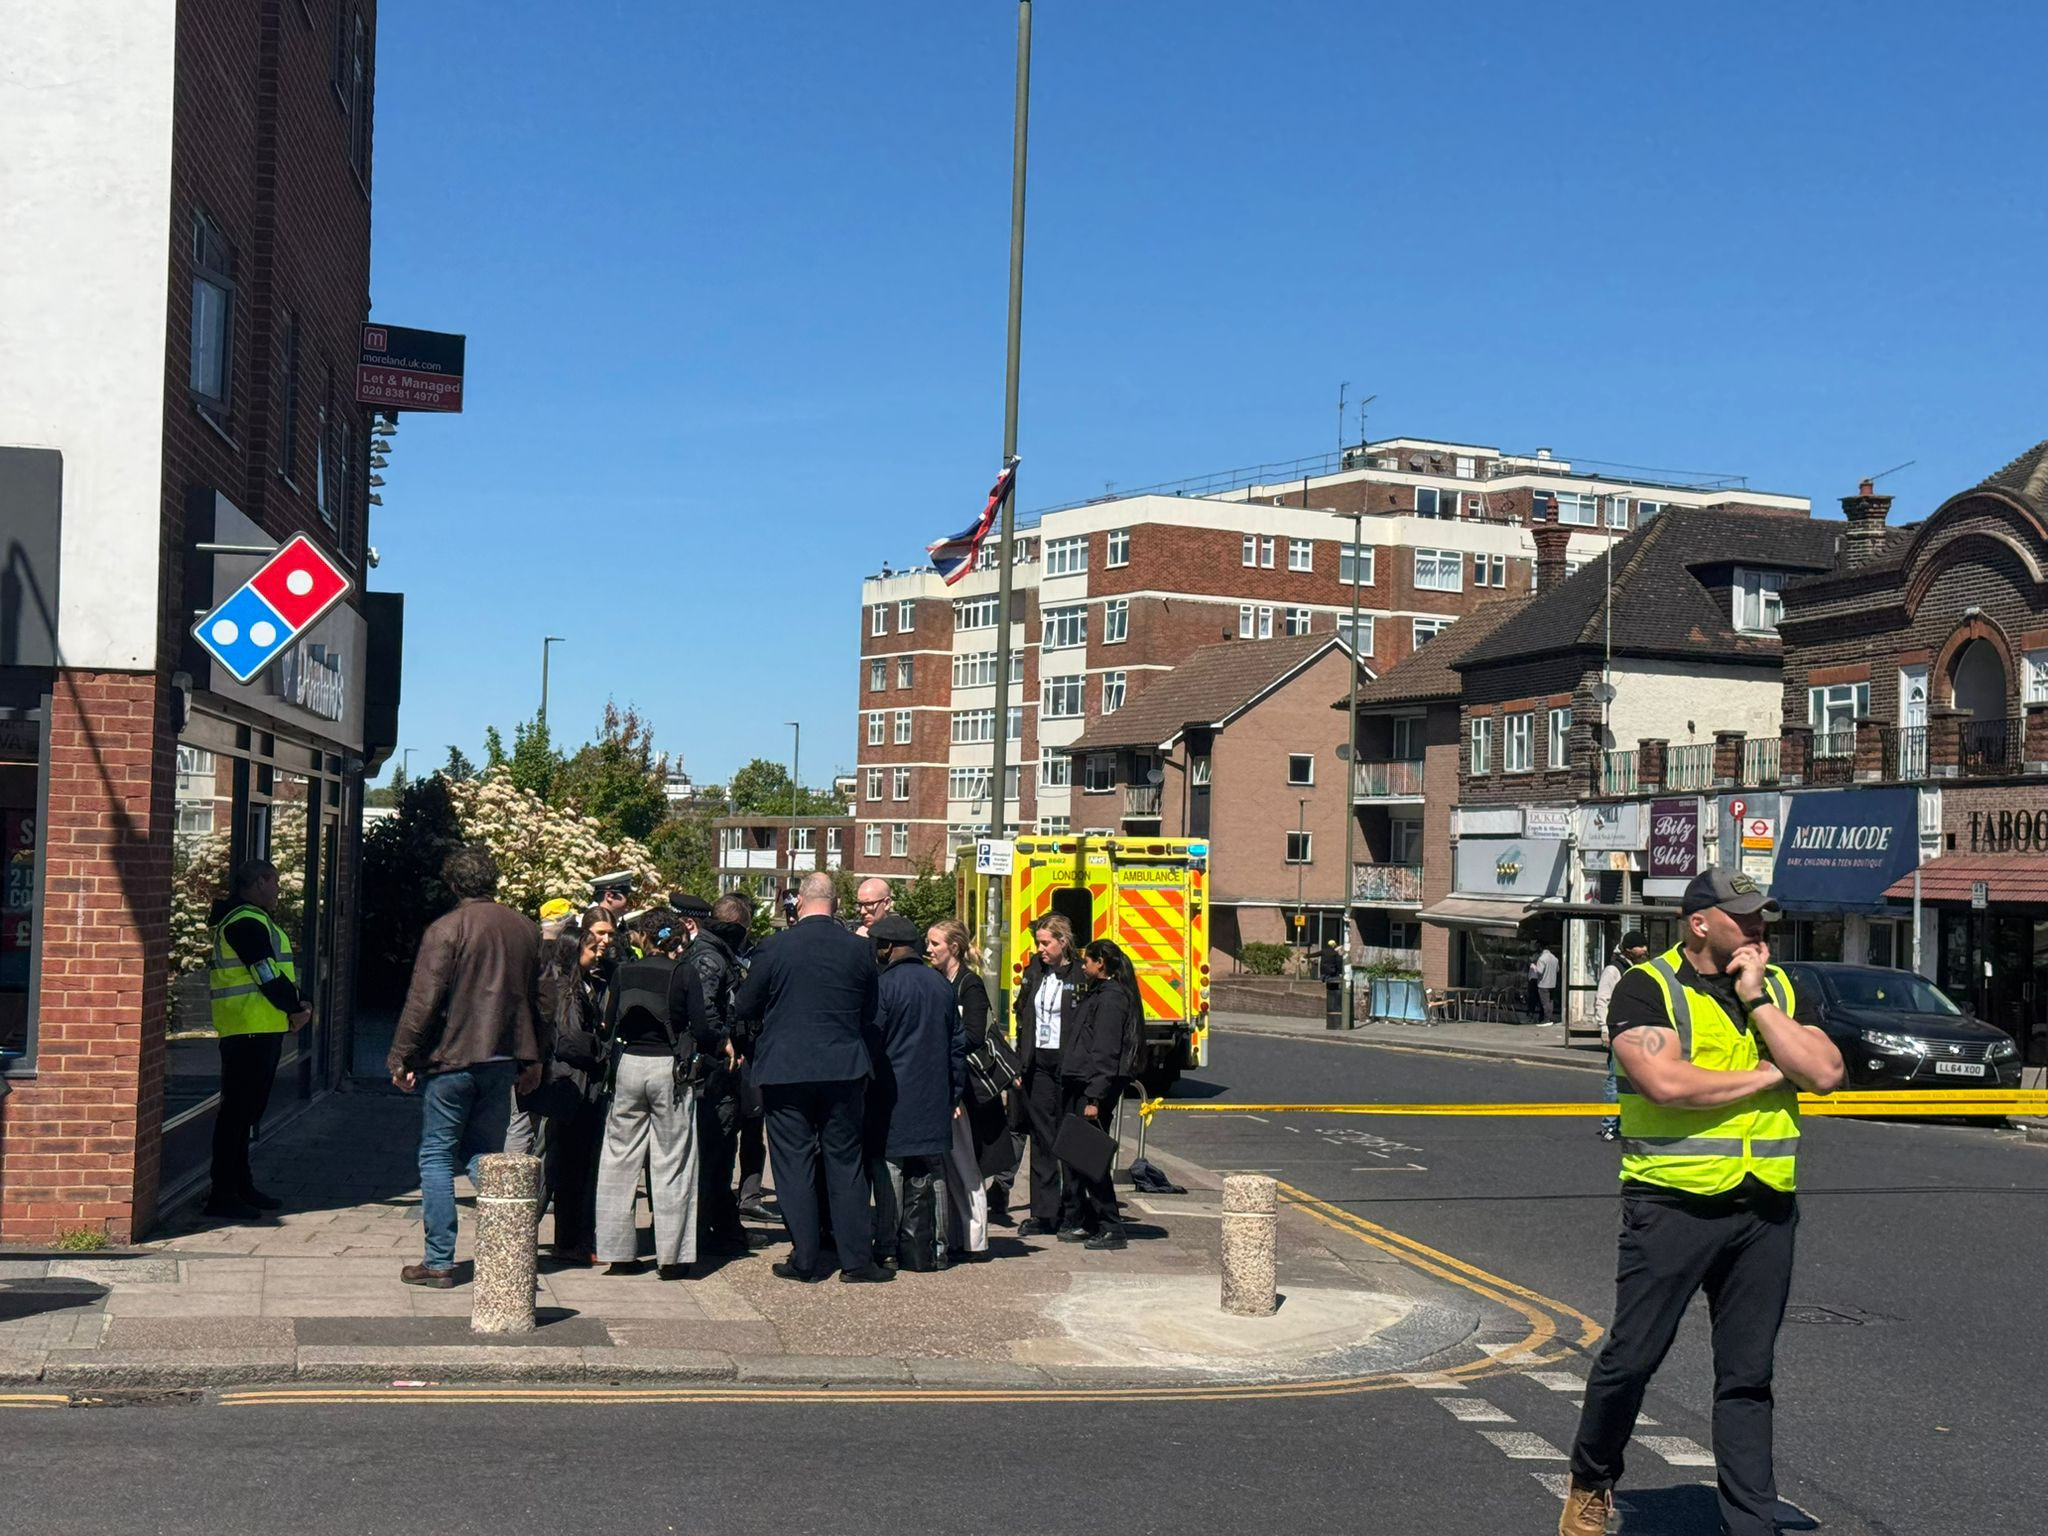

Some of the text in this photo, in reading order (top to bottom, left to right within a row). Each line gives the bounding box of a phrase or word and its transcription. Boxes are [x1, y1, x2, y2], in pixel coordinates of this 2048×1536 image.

[363, 353, 441, 371] moreland.uk.com
[363, 371, 460, 394] Let & Managed
[362, 385, 382, 396] 020
[385, 387, 410, 399] 8381
[413, 391, 440, 402] 4970
[1734, 801, 1744, 816] P
[1654, 815, 1696, 842] Bitz
[1791, 826, 1893, 850] MINI MODE
[981, 845, 990, 855] P
[1653, 846, 1696, 873] Glitz
[1053, 870, 1091, 880] LONDON
[1123, 871, 1181, 882] AMBULANCE
[1940, 1063, 1962, 1073] LL64
